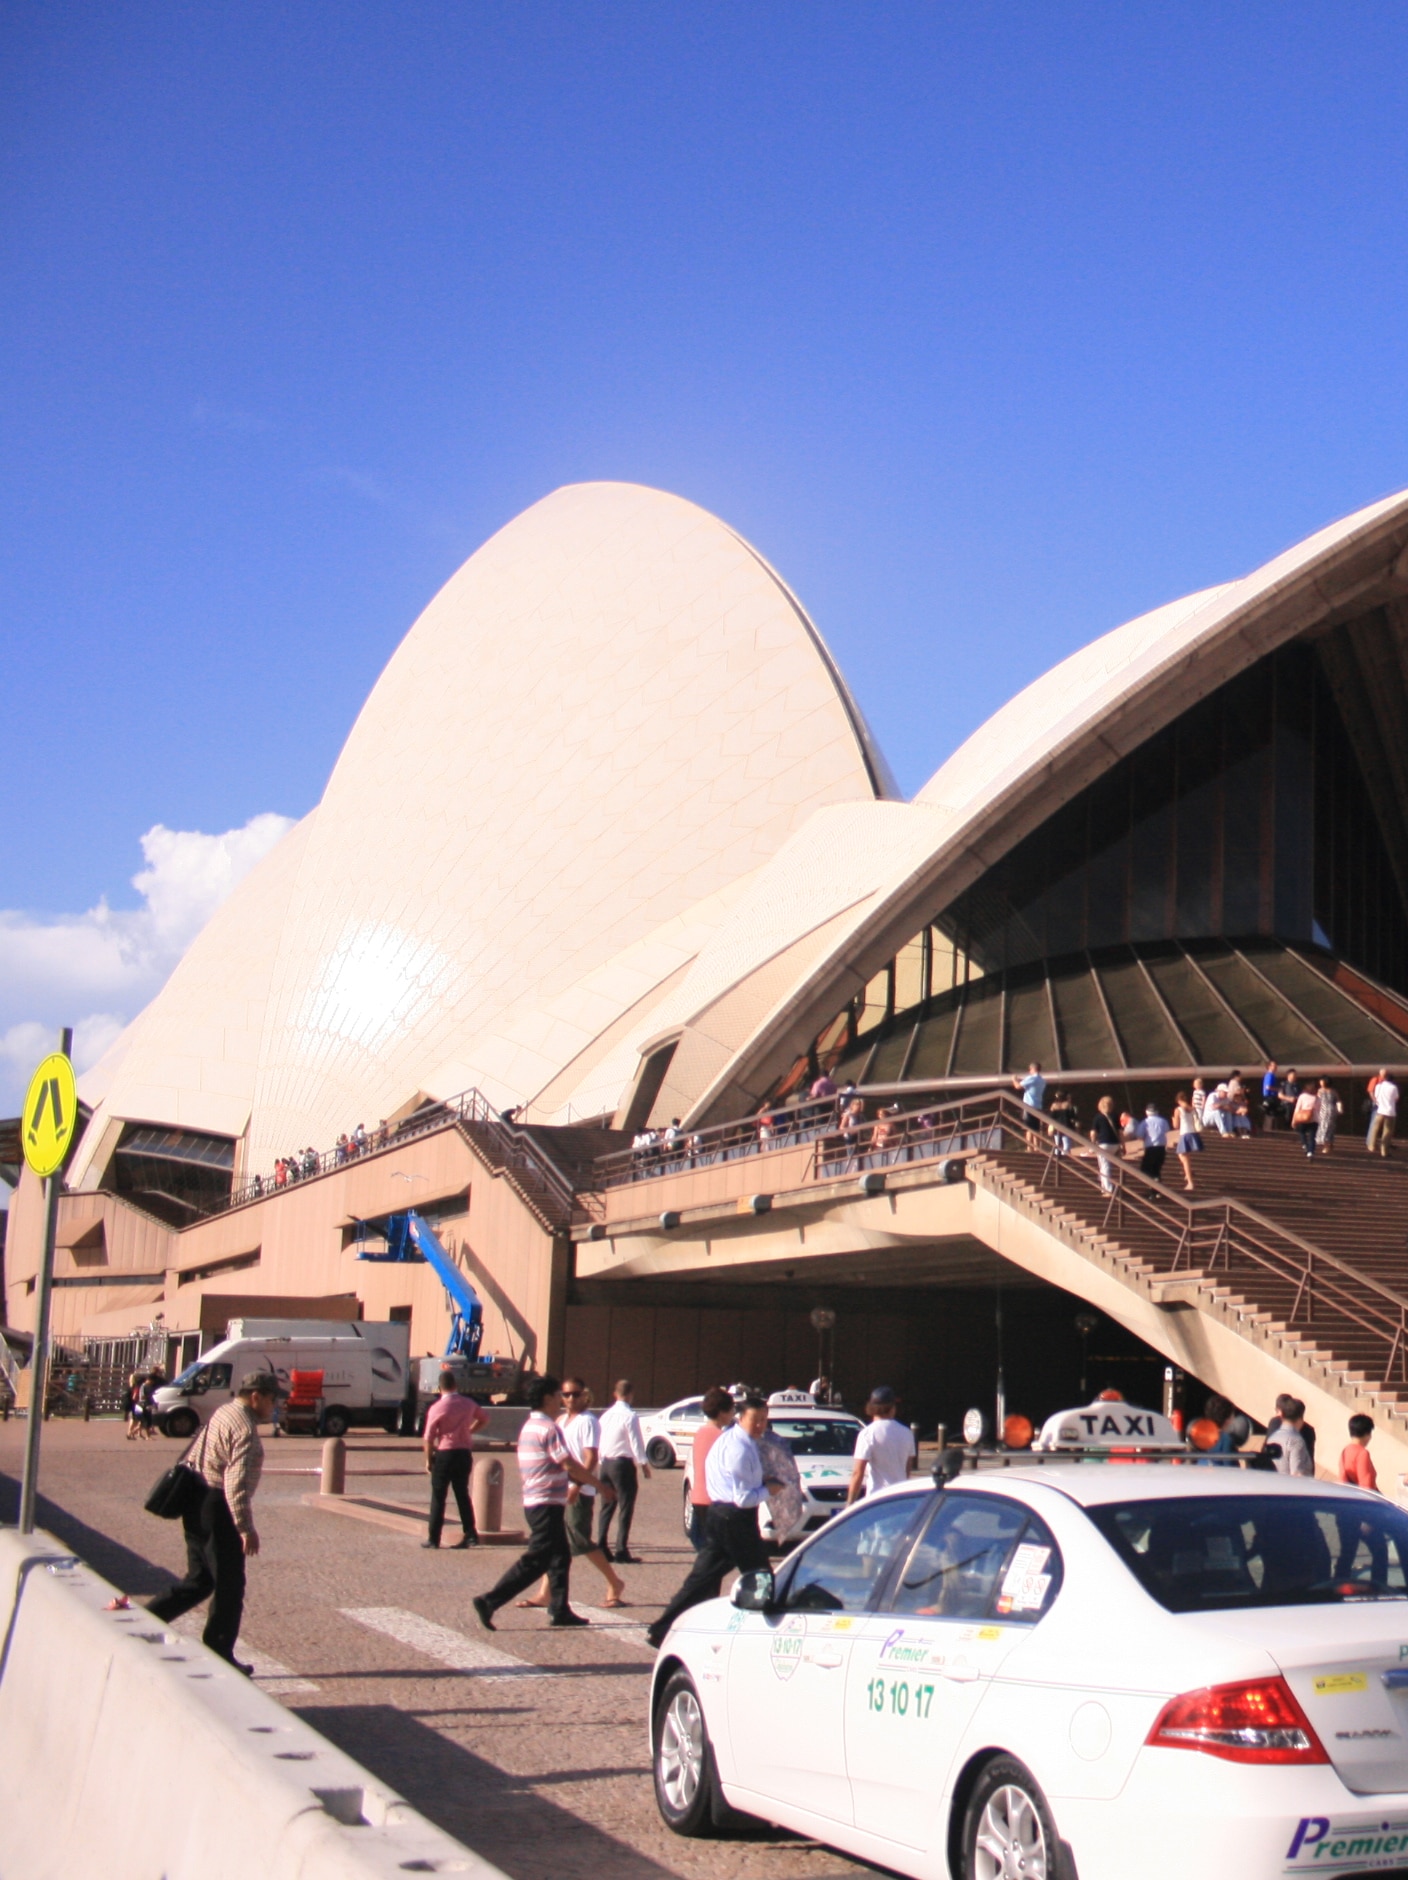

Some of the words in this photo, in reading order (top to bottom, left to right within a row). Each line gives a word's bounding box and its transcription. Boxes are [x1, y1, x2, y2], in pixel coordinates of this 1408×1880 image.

[1080, 1415, 1155, 1436] TAXI
[880, 1629, 930, 1662] Premier
[867, 1677, 885, 1712] 13
[890, 1680, 909, 1716] 10
[915, 1683, 935, 1718] 17
[1368, 1859, 1395, 1868] CABS
